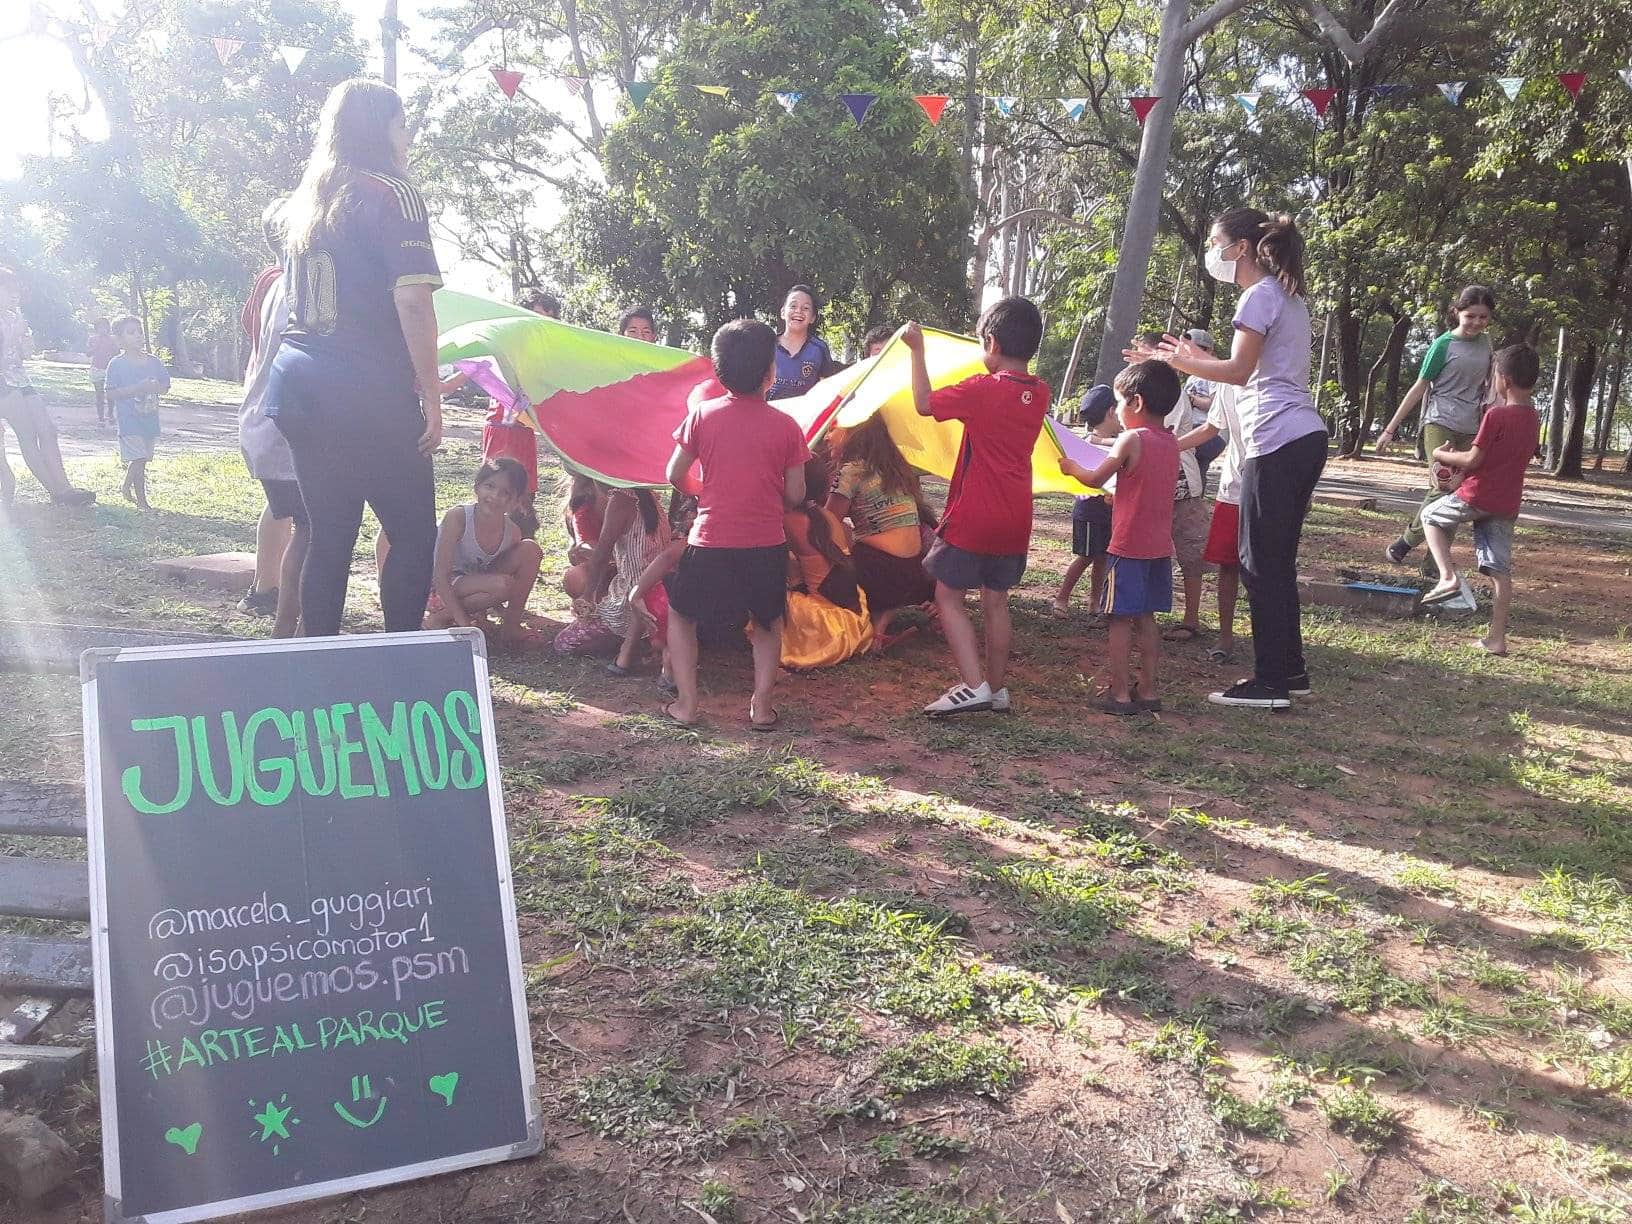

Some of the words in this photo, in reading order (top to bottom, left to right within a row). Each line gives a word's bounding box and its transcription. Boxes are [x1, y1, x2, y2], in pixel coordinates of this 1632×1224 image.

[121, 690, 486, 814] JUGUEMOS
[148, 877, 433, 938] @marcela_guggiari
[153, 911, 435, 981] @isapsicomotor1
[151, 946, 470, 1029] @juguemos.psm
[138, 999, 449, 1080] #ARTEALPARQUE
